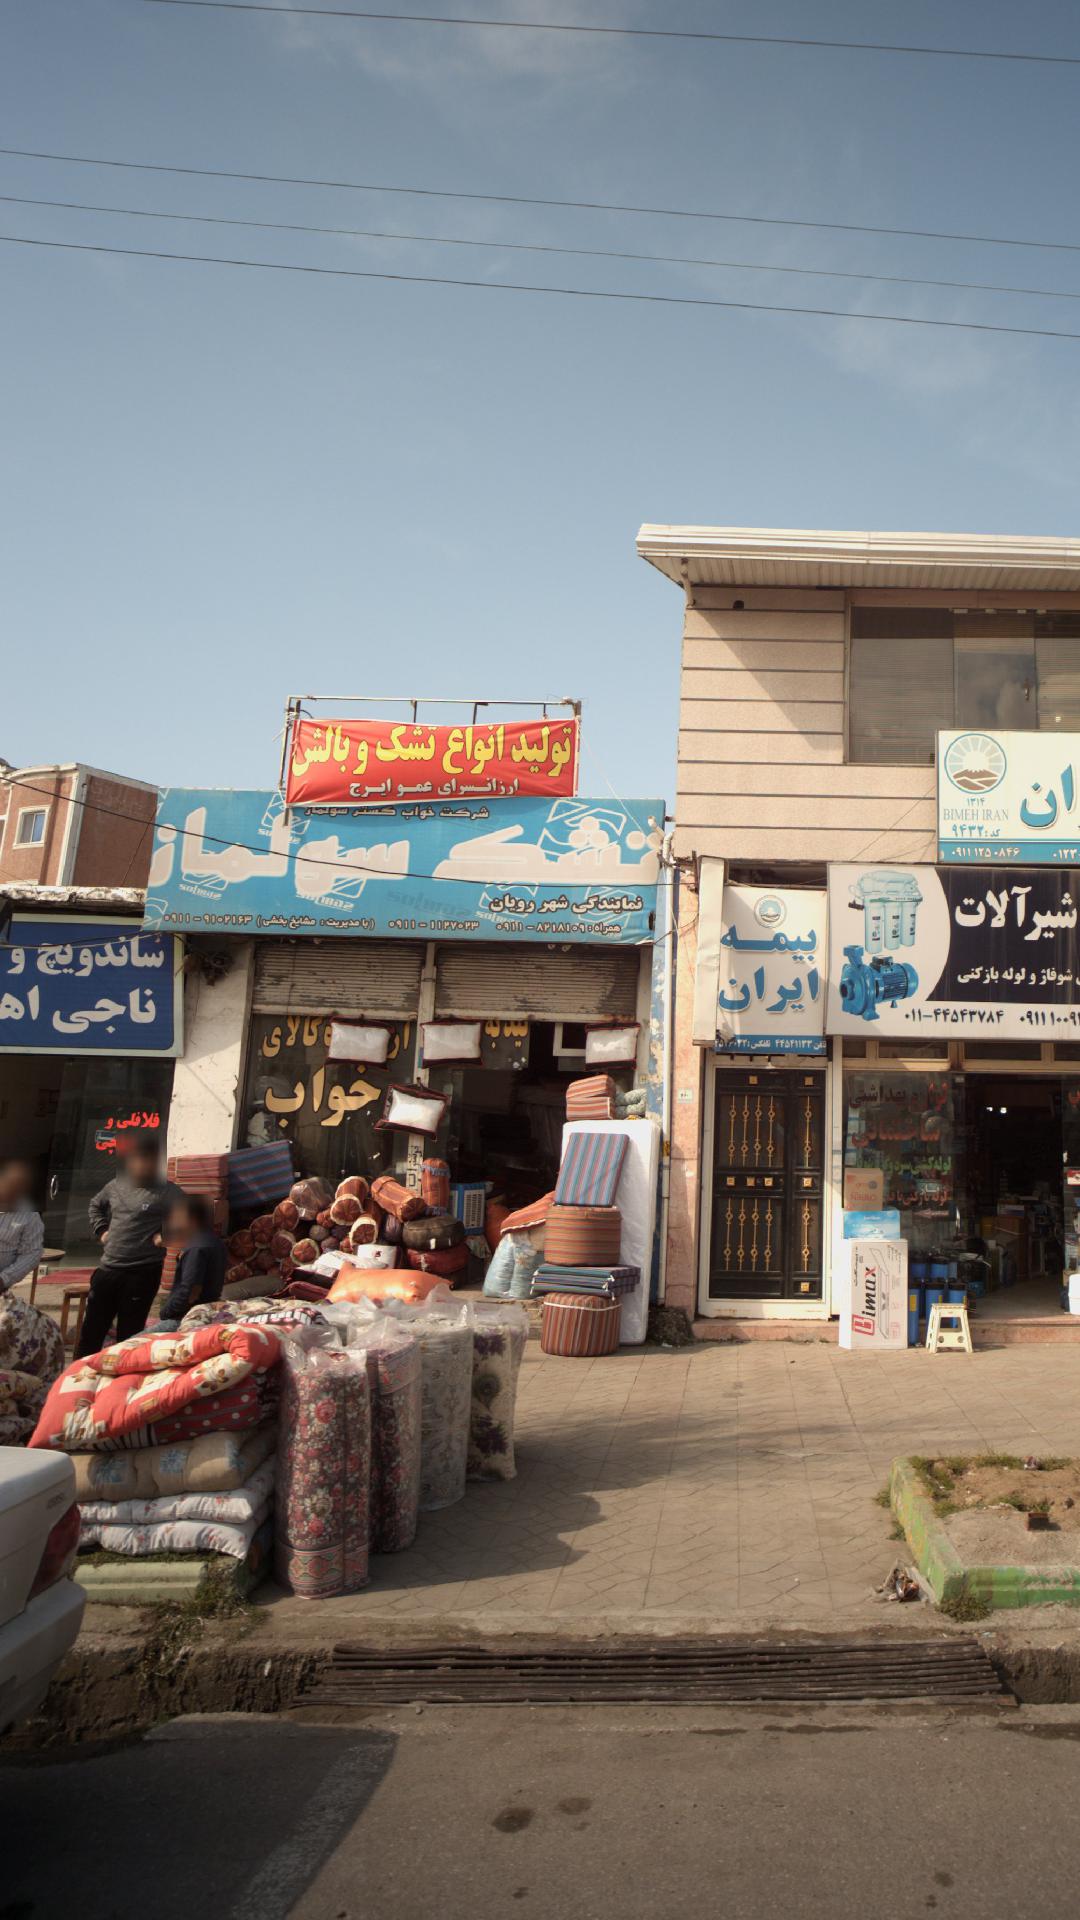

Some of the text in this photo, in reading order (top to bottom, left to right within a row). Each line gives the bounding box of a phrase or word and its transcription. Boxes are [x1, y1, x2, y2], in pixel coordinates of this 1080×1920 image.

[291, 725, 572, 777] تولید انواع تشک و بالش
[349, 778, 392, 798] ایرج
[397, 783, 433, 797] عمو
[401, 806, 436, 820] خواب
[438, 806, 490, 820] شرکت
[943, 808, 1009, 821] BIMEH IRAN
[147, 806, 661, 897] تشک سولماز
[488, 893, 644, 913] نمایندگی شهر رویان
[720, 923, 817, 962] بیمه
[7, 934, 165, 977] ساندویچ و
[1002, 967, 1026, 985] لوله
[1028, 972, 1037, 985] و
[1038, 967, 1073, 986] شوفاژ
[718, 965, 820, 1012] ایران
[52, 987, 156, 1035] ناجی
[264, 1064, 383, 1128] خواب
